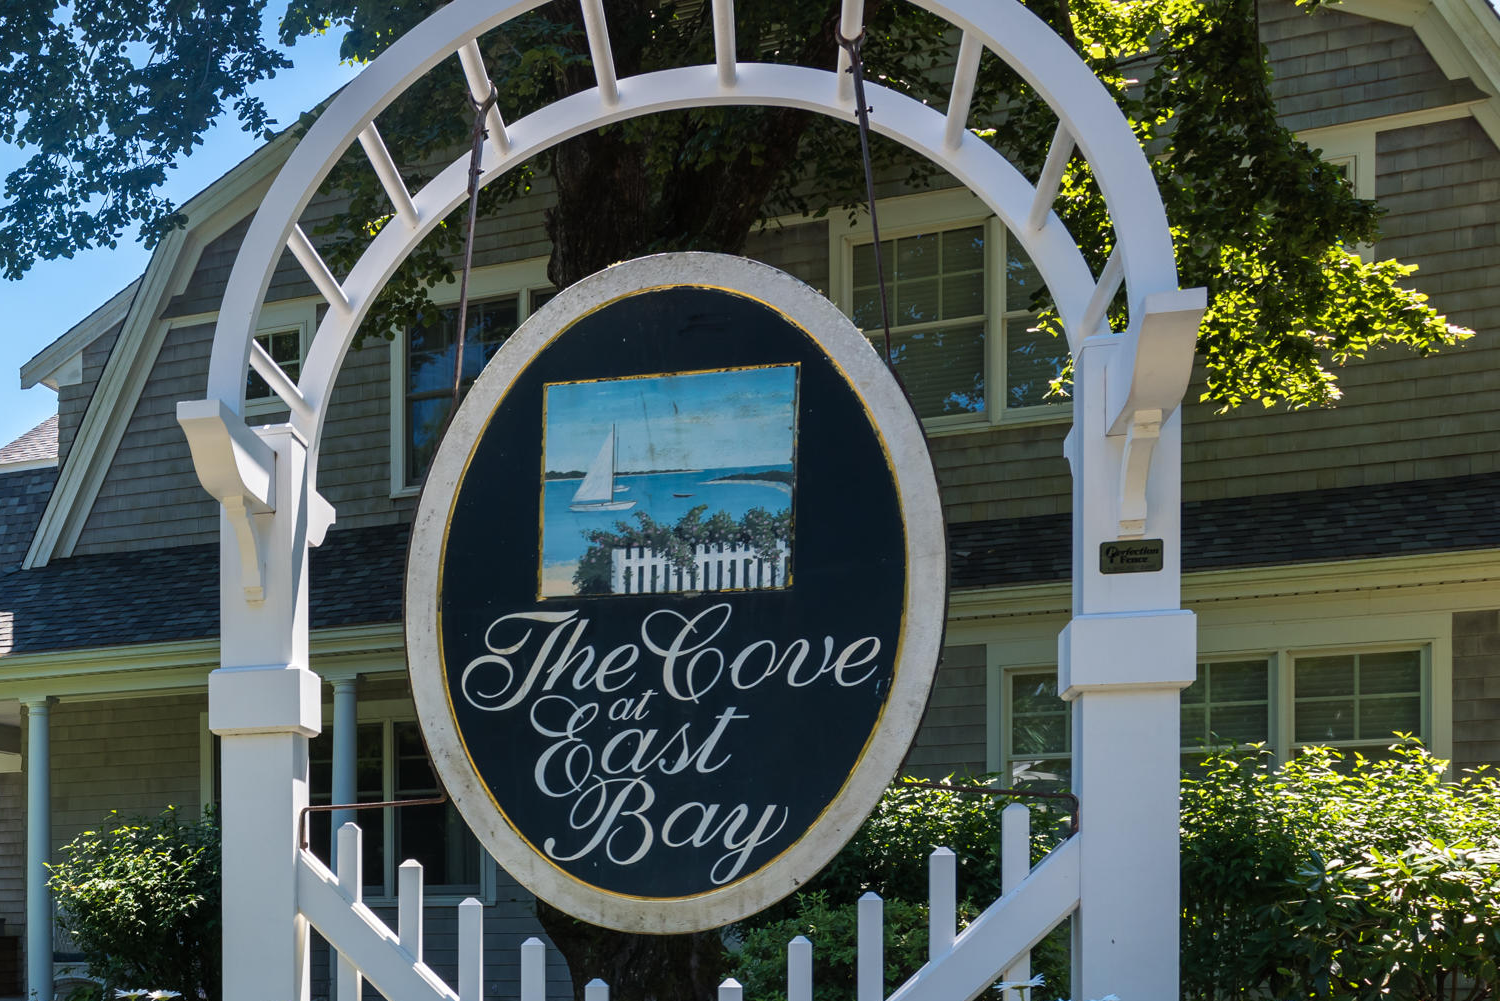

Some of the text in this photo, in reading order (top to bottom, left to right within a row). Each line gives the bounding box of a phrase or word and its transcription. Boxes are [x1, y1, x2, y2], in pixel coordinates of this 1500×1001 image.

[462, 603, 881, 711] The Cove
[608, 689, 659, 721] at
[530, 695, 750, 798] East
[544, 774, 789, 885] Bay
